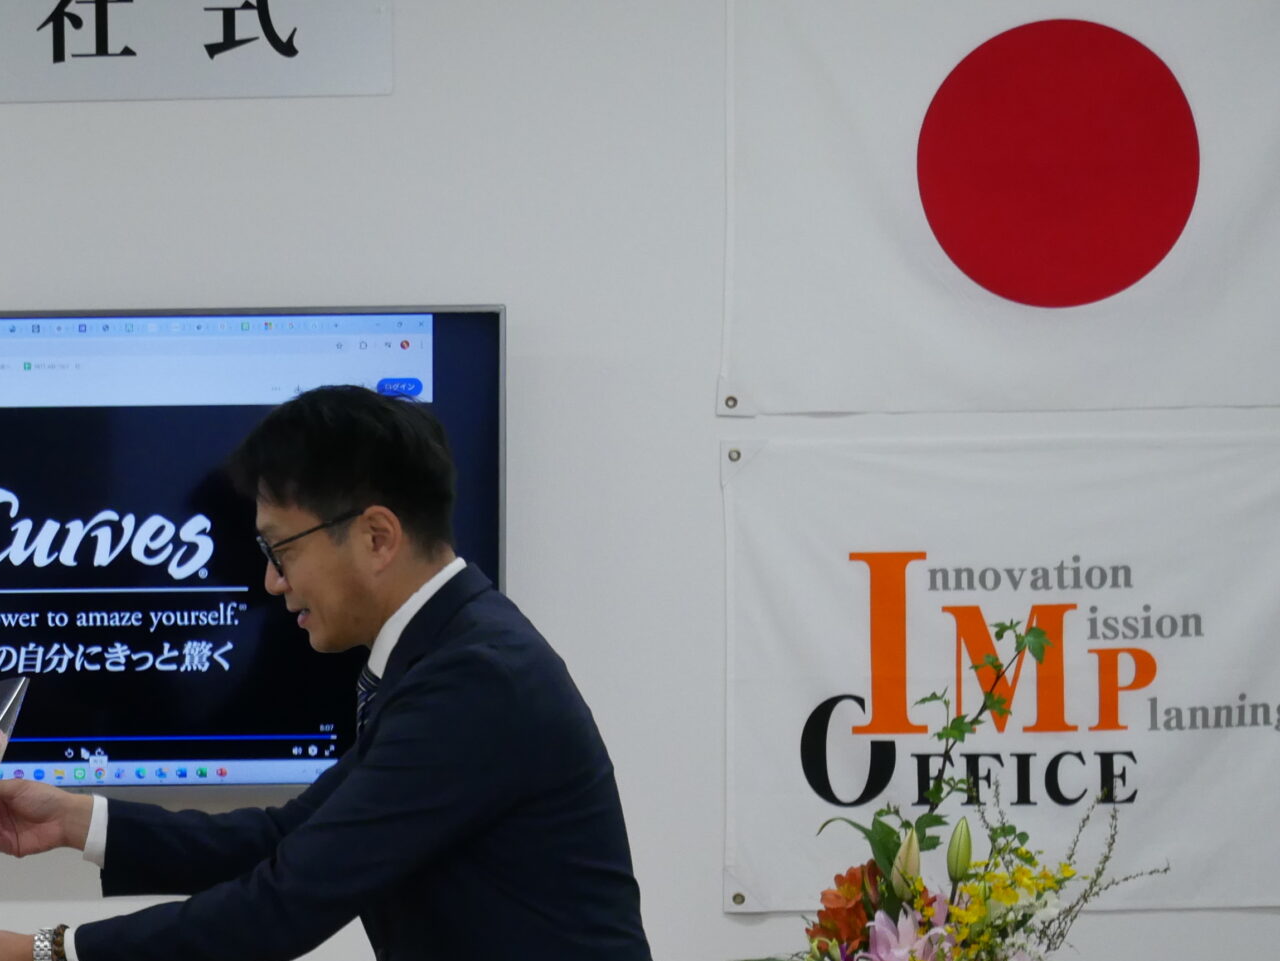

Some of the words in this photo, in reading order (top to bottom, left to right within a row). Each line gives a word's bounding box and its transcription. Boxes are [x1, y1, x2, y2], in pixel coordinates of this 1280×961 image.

[47, 609, 69, 628] to
[76, 610, 143, 627] amaze
[1148, 692, 1280, 732] lannin
[800, 694, 1138, 808] OFFICE
